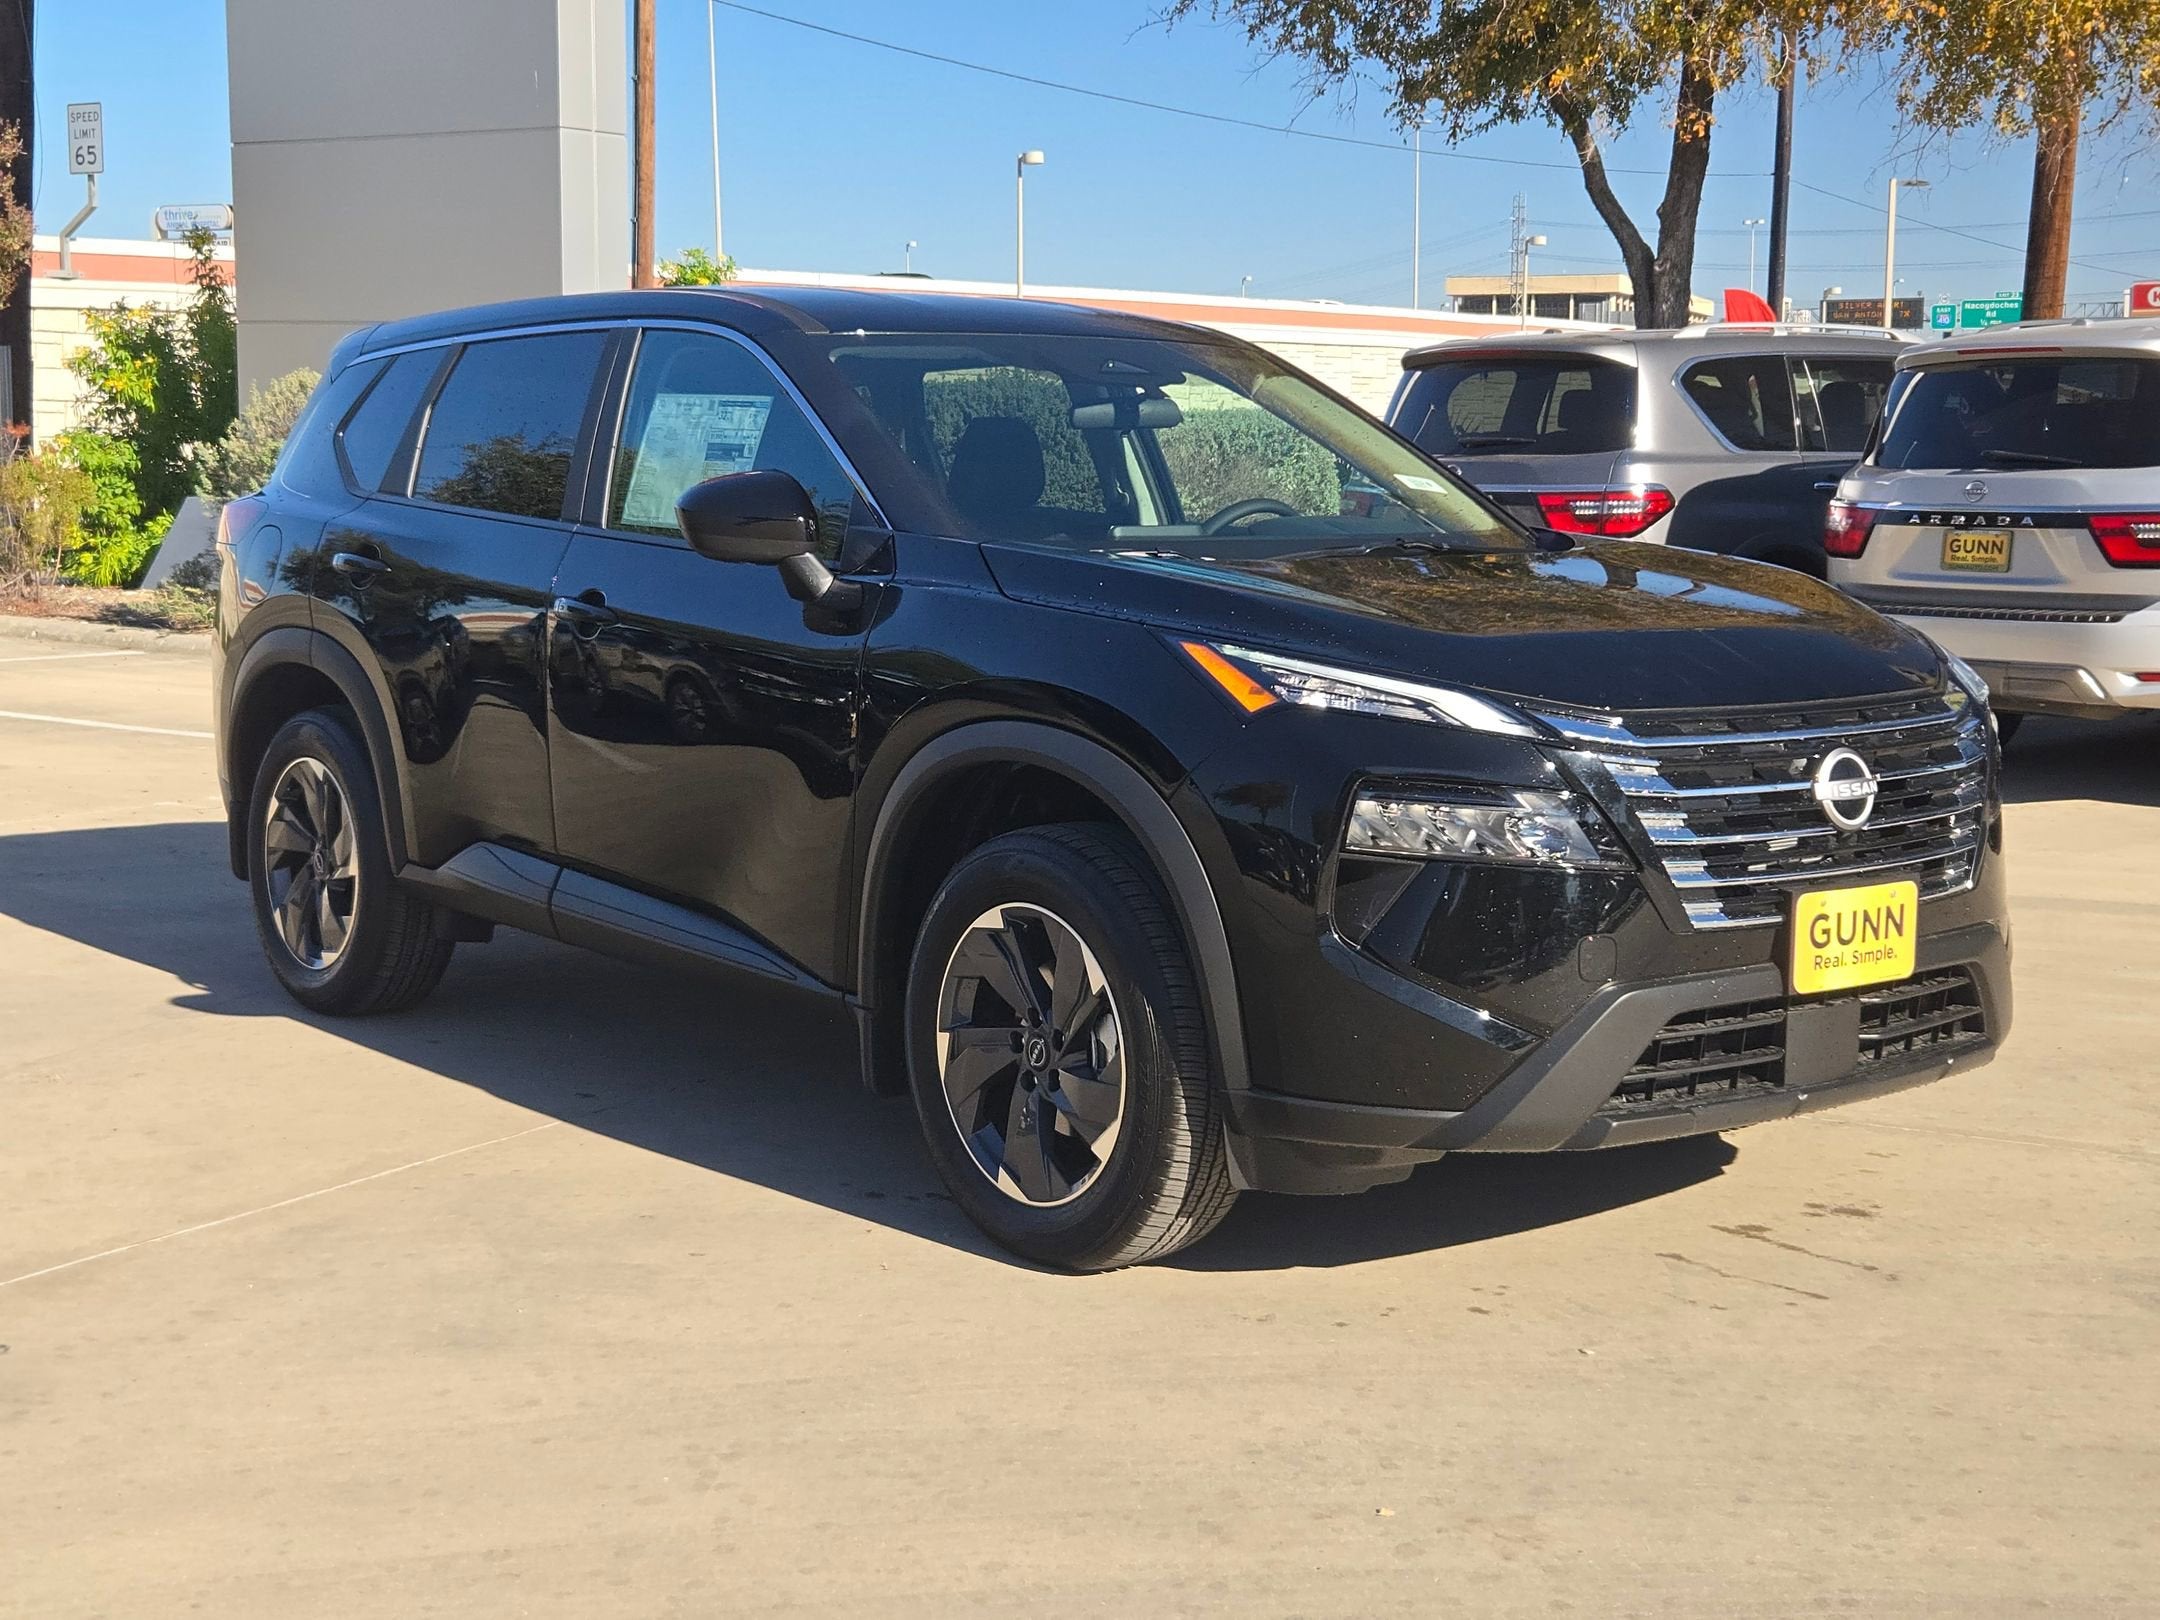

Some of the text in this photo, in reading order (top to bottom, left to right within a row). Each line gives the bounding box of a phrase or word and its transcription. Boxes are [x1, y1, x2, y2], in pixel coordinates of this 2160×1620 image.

[71, 111, 99, 123] SPEED
[74, 128, 96, 140] LIMIT
[75, 145, 97, 166] 65
[164, 207, 193, 220] thrive
[1964, 302, 2019, 310] Nacogdoches
[1985, 310, 1997, 318] Rd
[1908, 514, 2034, 526] ARMADA
[1949, 538, 2005, 554] GUNN
[1950, 554, 1998, 564] Real. Simple.
[1817, 780, 1878, 798] ISSAN
[1809, 903, 1905, 949] GUNN
[1814, 943, 1898, 971] Real. Simple.
